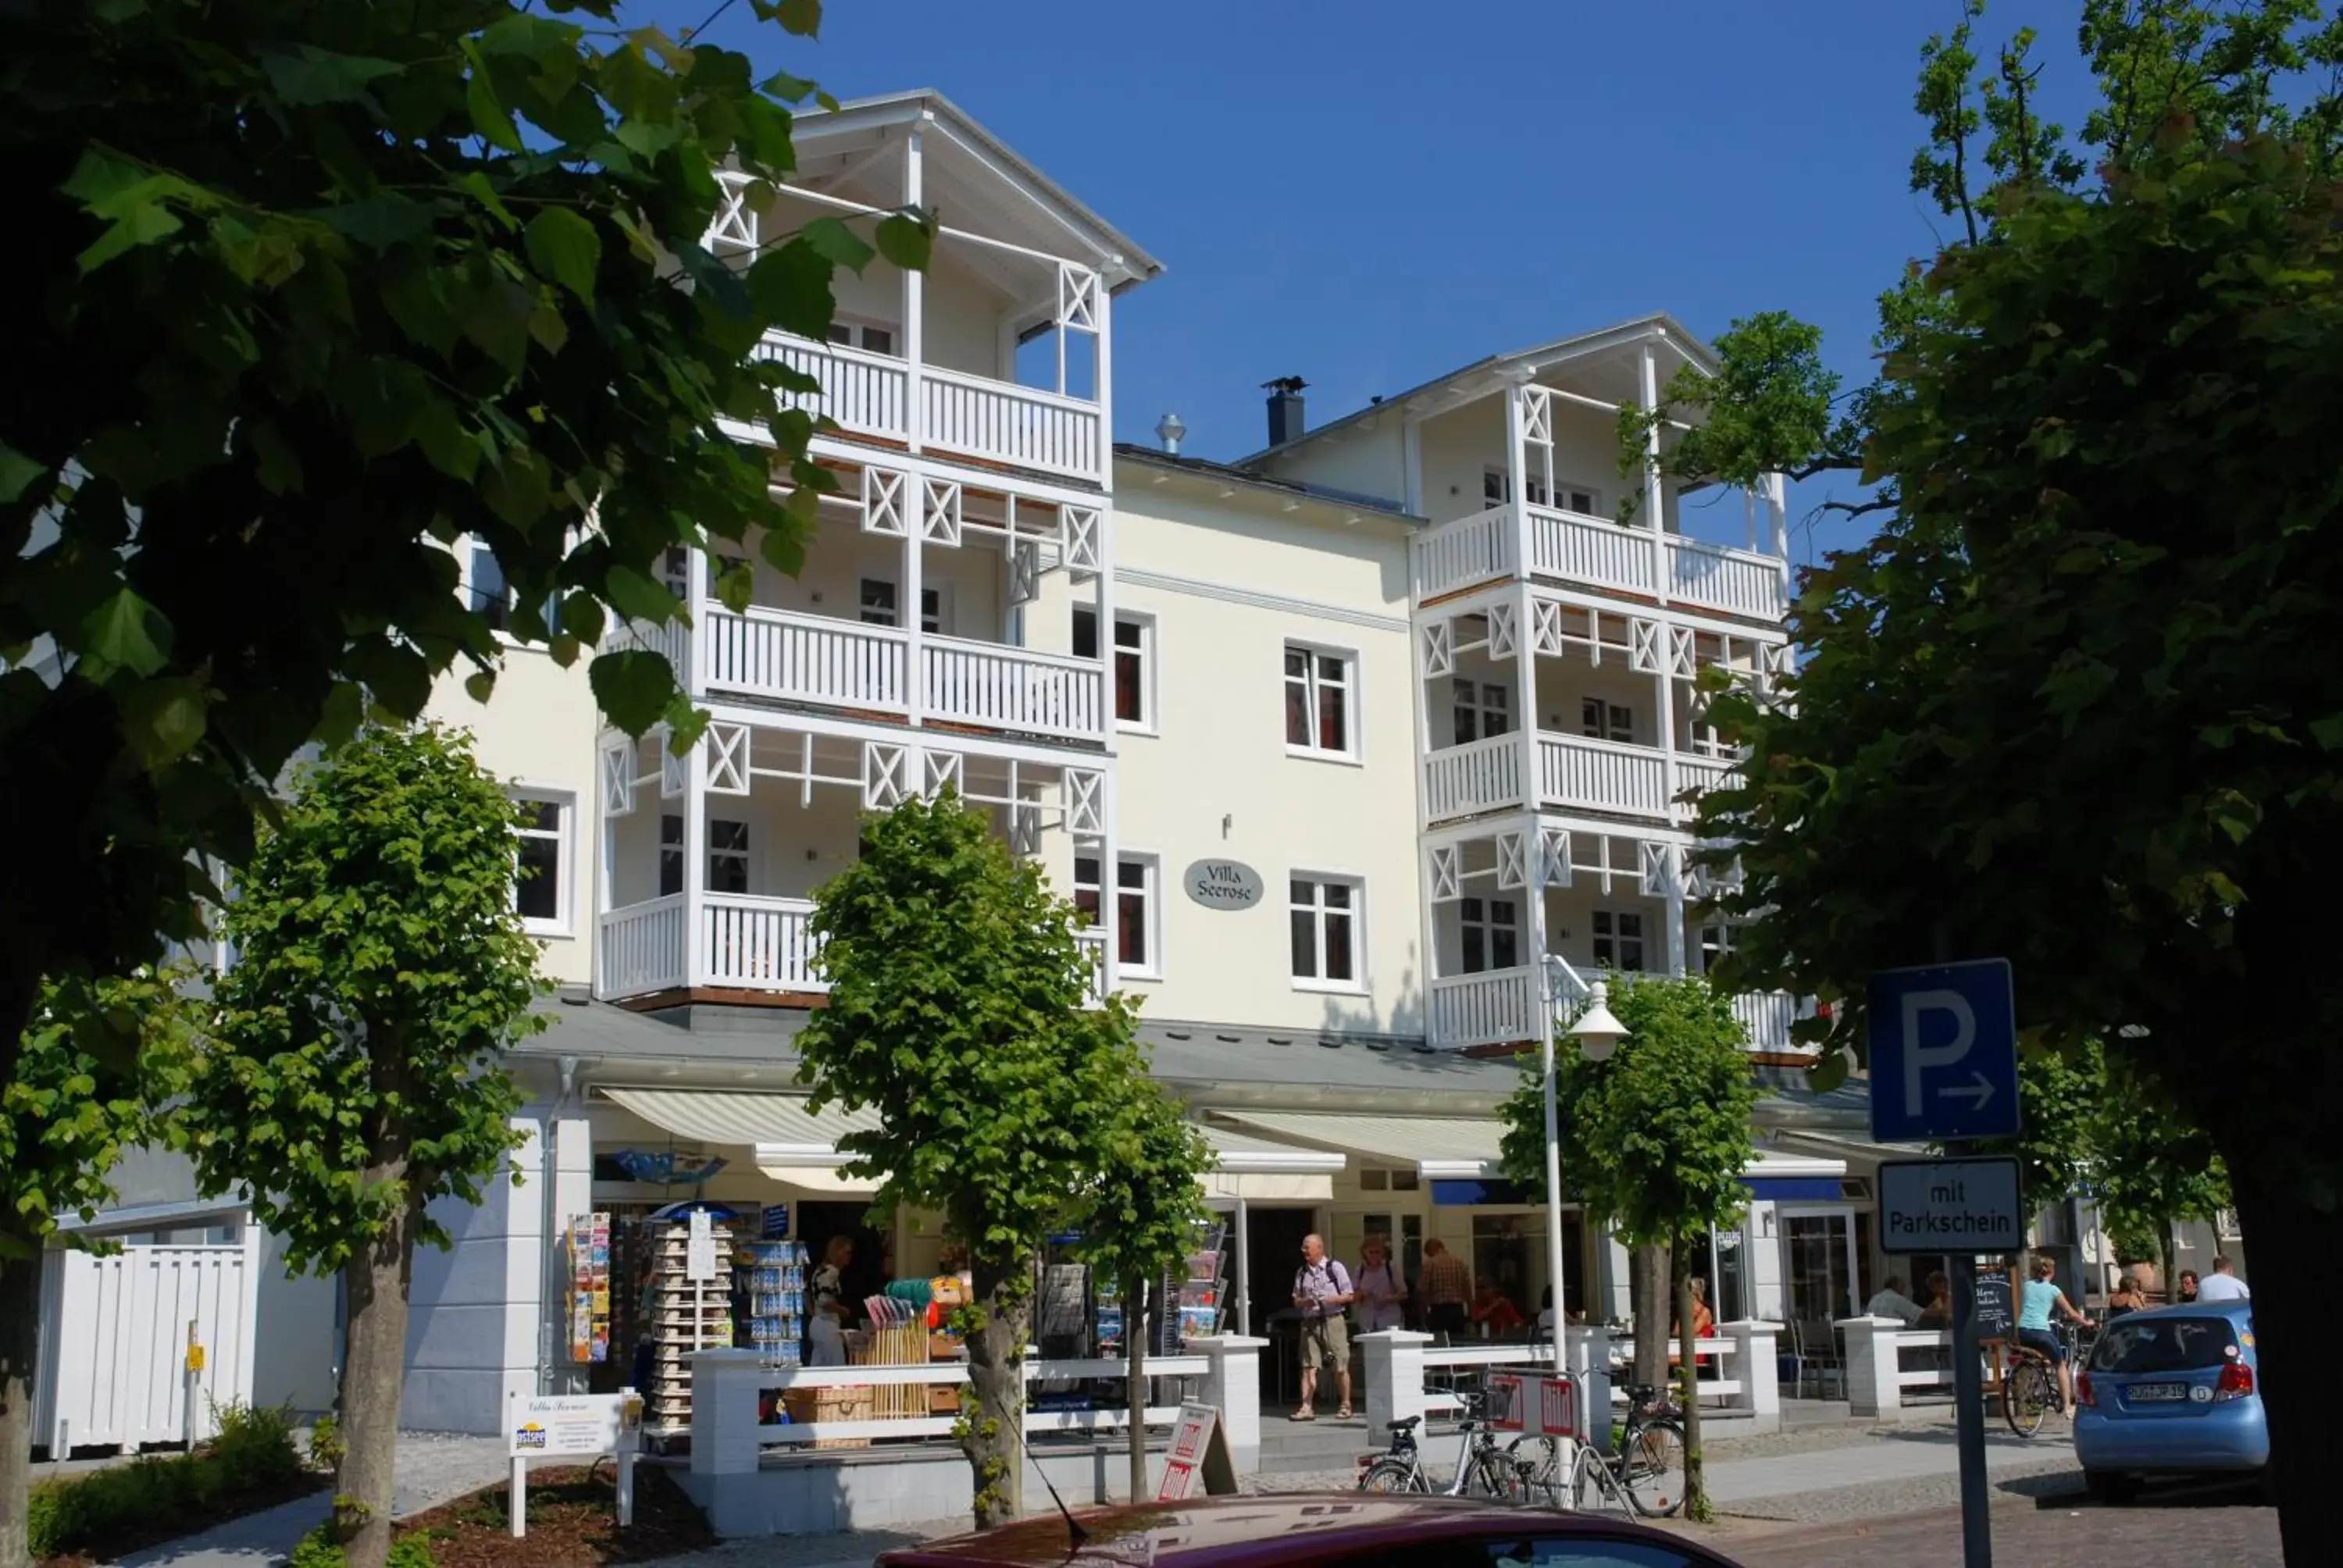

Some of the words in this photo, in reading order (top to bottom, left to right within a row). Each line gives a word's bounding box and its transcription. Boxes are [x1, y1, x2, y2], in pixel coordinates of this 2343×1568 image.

[1198, 881, 1250, 900] Seerose
[1901, 989, 1977, 1117] P
[1930, 1181, 1966, 1203] mit
[1890, 1211, 2010, 1234] Parkschein
[2197, 1388, 2206, 1400] D
[1542, 1384, 1571, 1429] Bild
